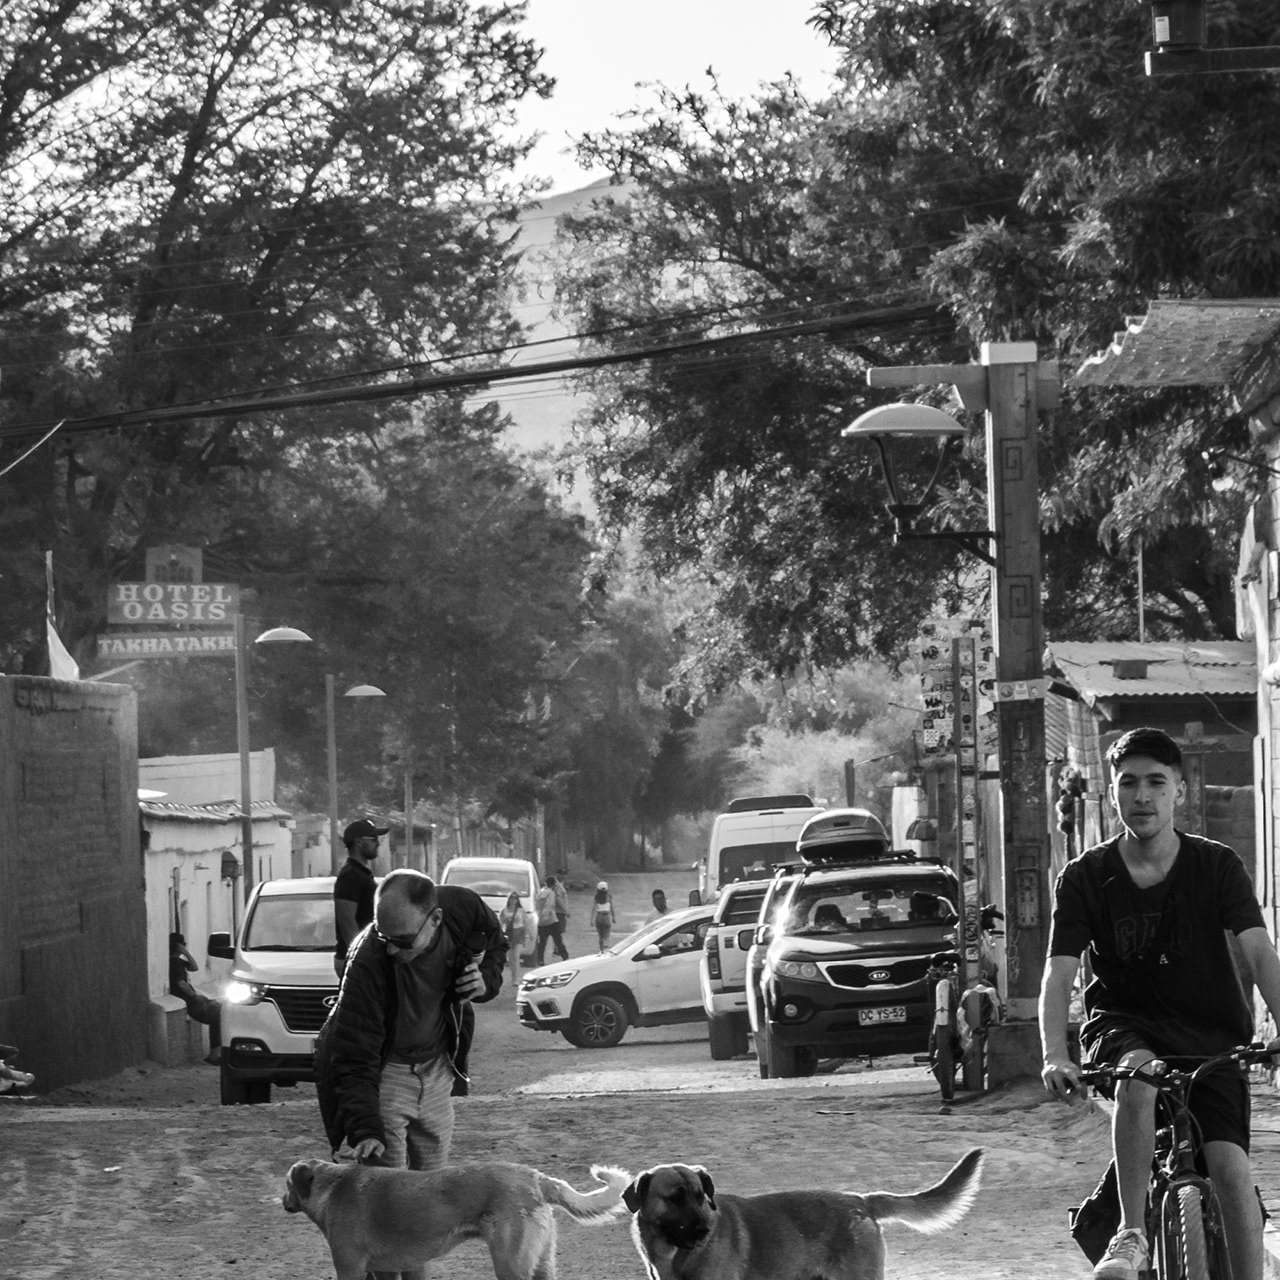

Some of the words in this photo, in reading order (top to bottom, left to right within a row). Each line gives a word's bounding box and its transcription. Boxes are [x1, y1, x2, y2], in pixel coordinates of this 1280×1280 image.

[117, 584, 232, 602] HOTEL
[123, 602, 226, 620] OASIS
[173, 636, 236, 651] TAKH
